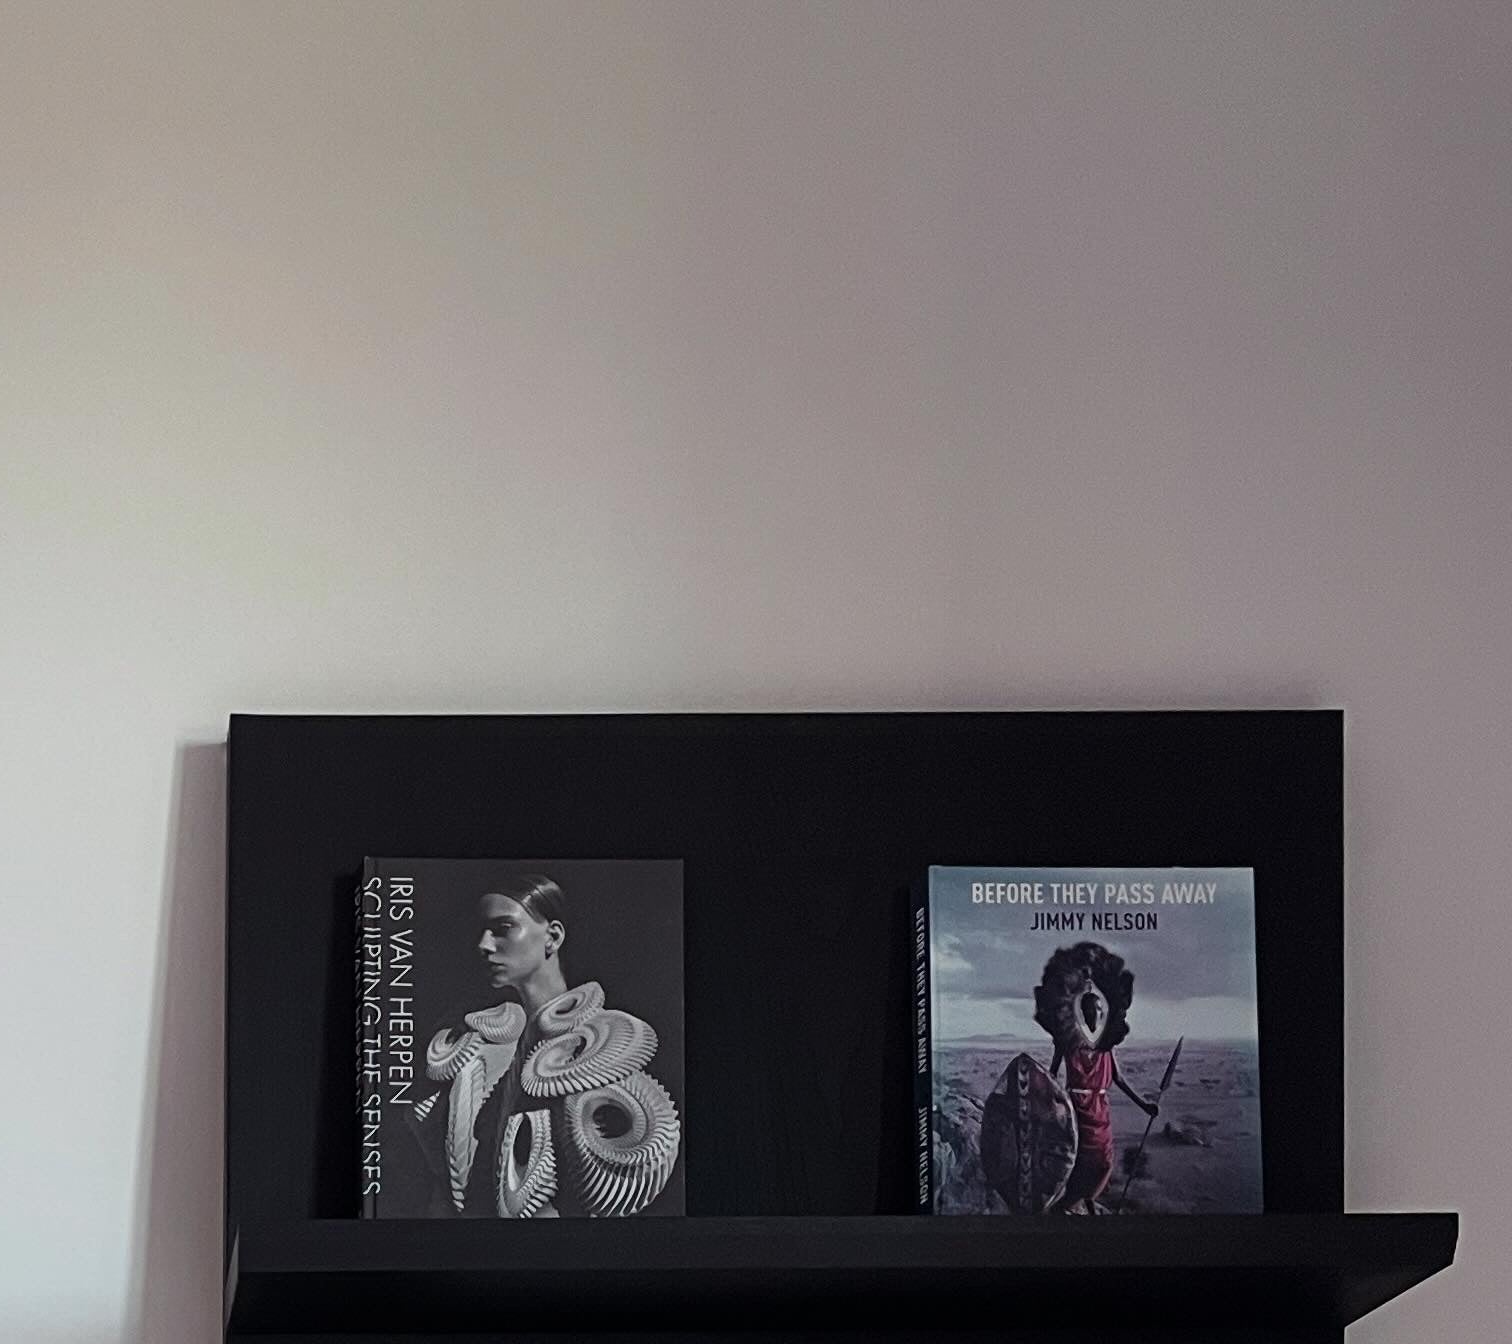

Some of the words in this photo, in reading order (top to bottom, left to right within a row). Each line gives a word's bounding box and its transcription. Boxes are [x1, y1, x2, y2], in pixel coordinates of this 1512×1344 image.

[389, 877, 414, 920] IRIS
[971, 882, 1044, 904] BEFORE
[1050, 882, 1098, 904] THEY
[1104, 882, 1155, 904] PASS
[1161, 882, 1217, 904] AWAY
[1030, 912, 1086, 931] JIMMY
[1092, 912, 1158, 931] NELSON
[389, 929, 414, 987] VAN
[363, 1033, 382, 1083] THE
[389, 998, 414, 1104] HERPEN
